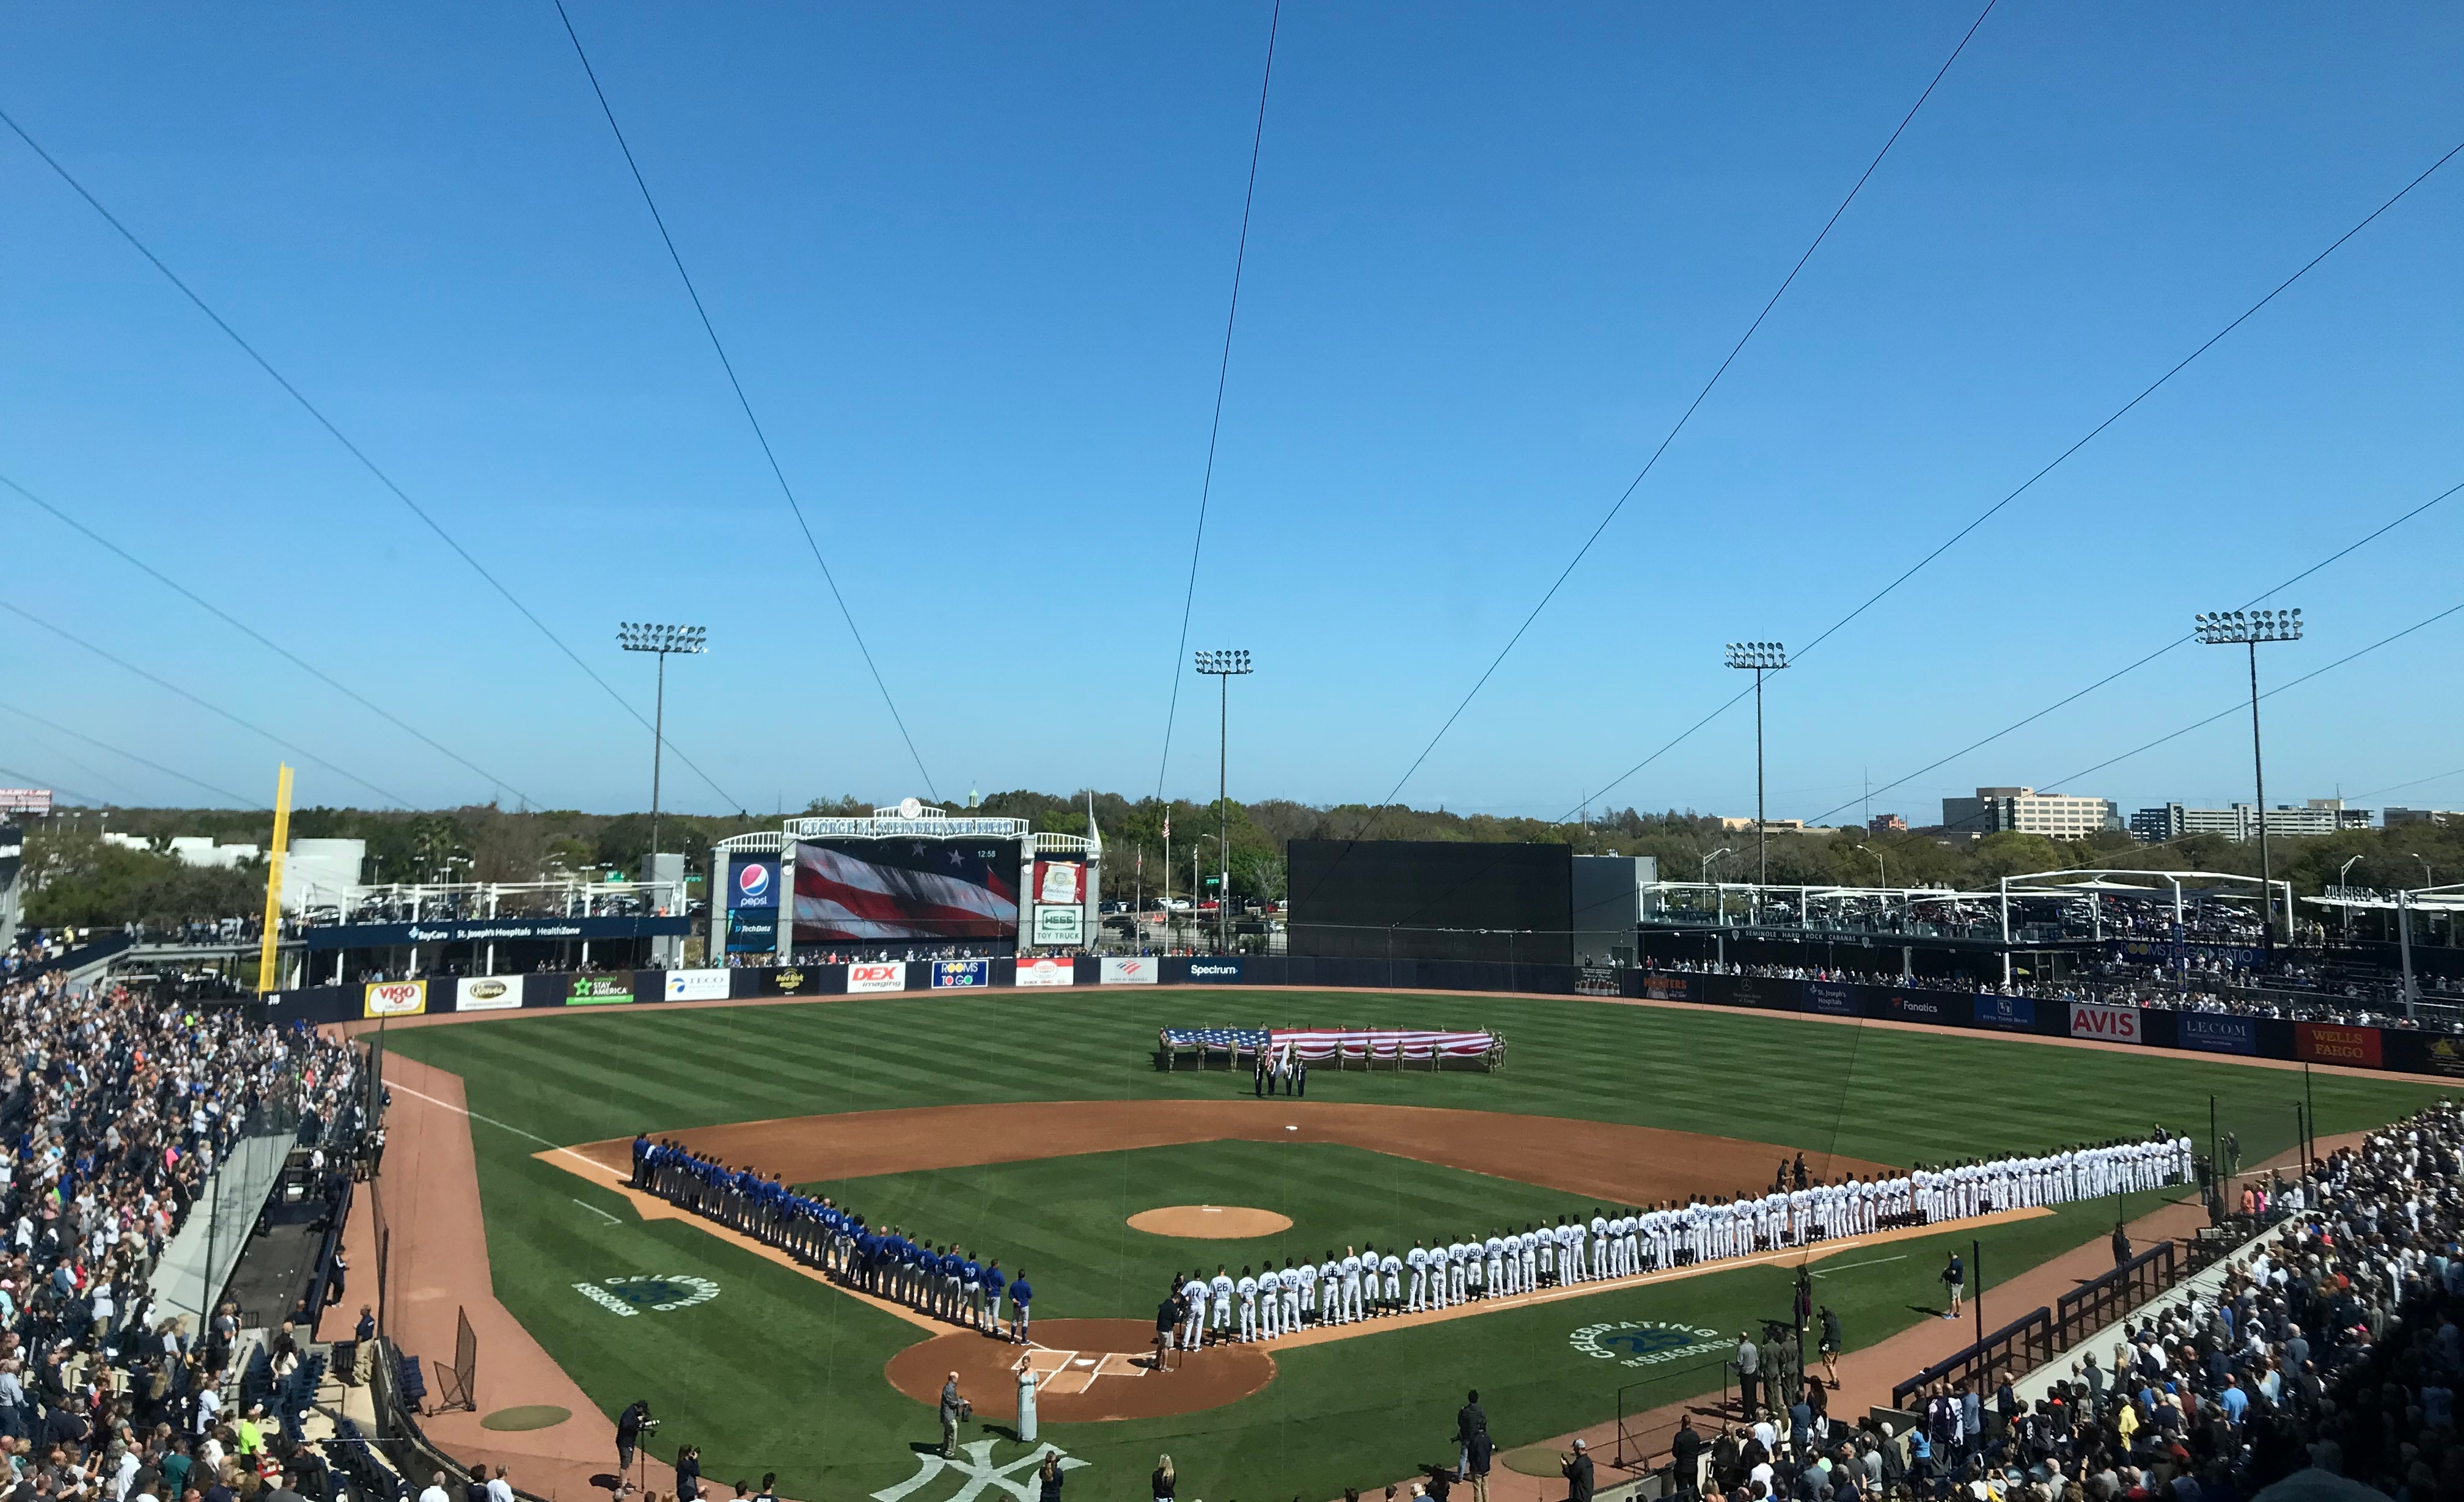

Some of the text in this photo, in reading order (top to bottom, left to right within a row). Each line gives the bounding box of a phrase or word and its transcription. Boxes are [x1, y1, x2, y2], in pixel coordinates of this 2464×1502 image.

[801, 819, 854, 833] GEORGE
[876, 819, 975, 833] STEINBRENNER
[977, 821, 1013, 833] FIELD
[741, 896, 767, 907] pepsi
[418, 930, 449, 942] BayCare
[457, 929, 467, 939] St.
[466, 928, 494, 940] Joseph's
[495, 927, 531, 938] Hospitals
[2121, 942, 2166, 956] ROOMS
[2218, 948, 2253, 962] PATIO
[942, 962, 978, 973] ROOMS
[1191, 964, 1236, 976] Spectrum
[852, 965, 897, 981] DEX
[942, 975, 974, 986] TO GO
[593, 987, 627, 995] AMERICA
[1818, 997, 1842, 1006] Hospitals
[1904, 1000, 1938, 1013] Fanatics
[2072, 1009, 2135, 1036] AVIS
[2312, 1030, 2363, 1044] WELLS
[2315, 1044, 2363, 1058] FARGO
[1597, 1222, 1605, 1231] 27
[945, 1260, 955, 1270] 17
[1370, 1257, 1376, 1266] 12
[1387, 1262, 1397, 1270] 74
[964, 1267, 976, 1277] 39
[1348, 1263, 1358, 1272] 38
[1286, 1275, 1297, 1284] 72
[1305, 1271, 1314, 1280] 77
[1266, 1278, 1277, 1287] 29
[1192, 1288, 1201, 1296] 17
[1244, 1284, 1253, 1292] 25
